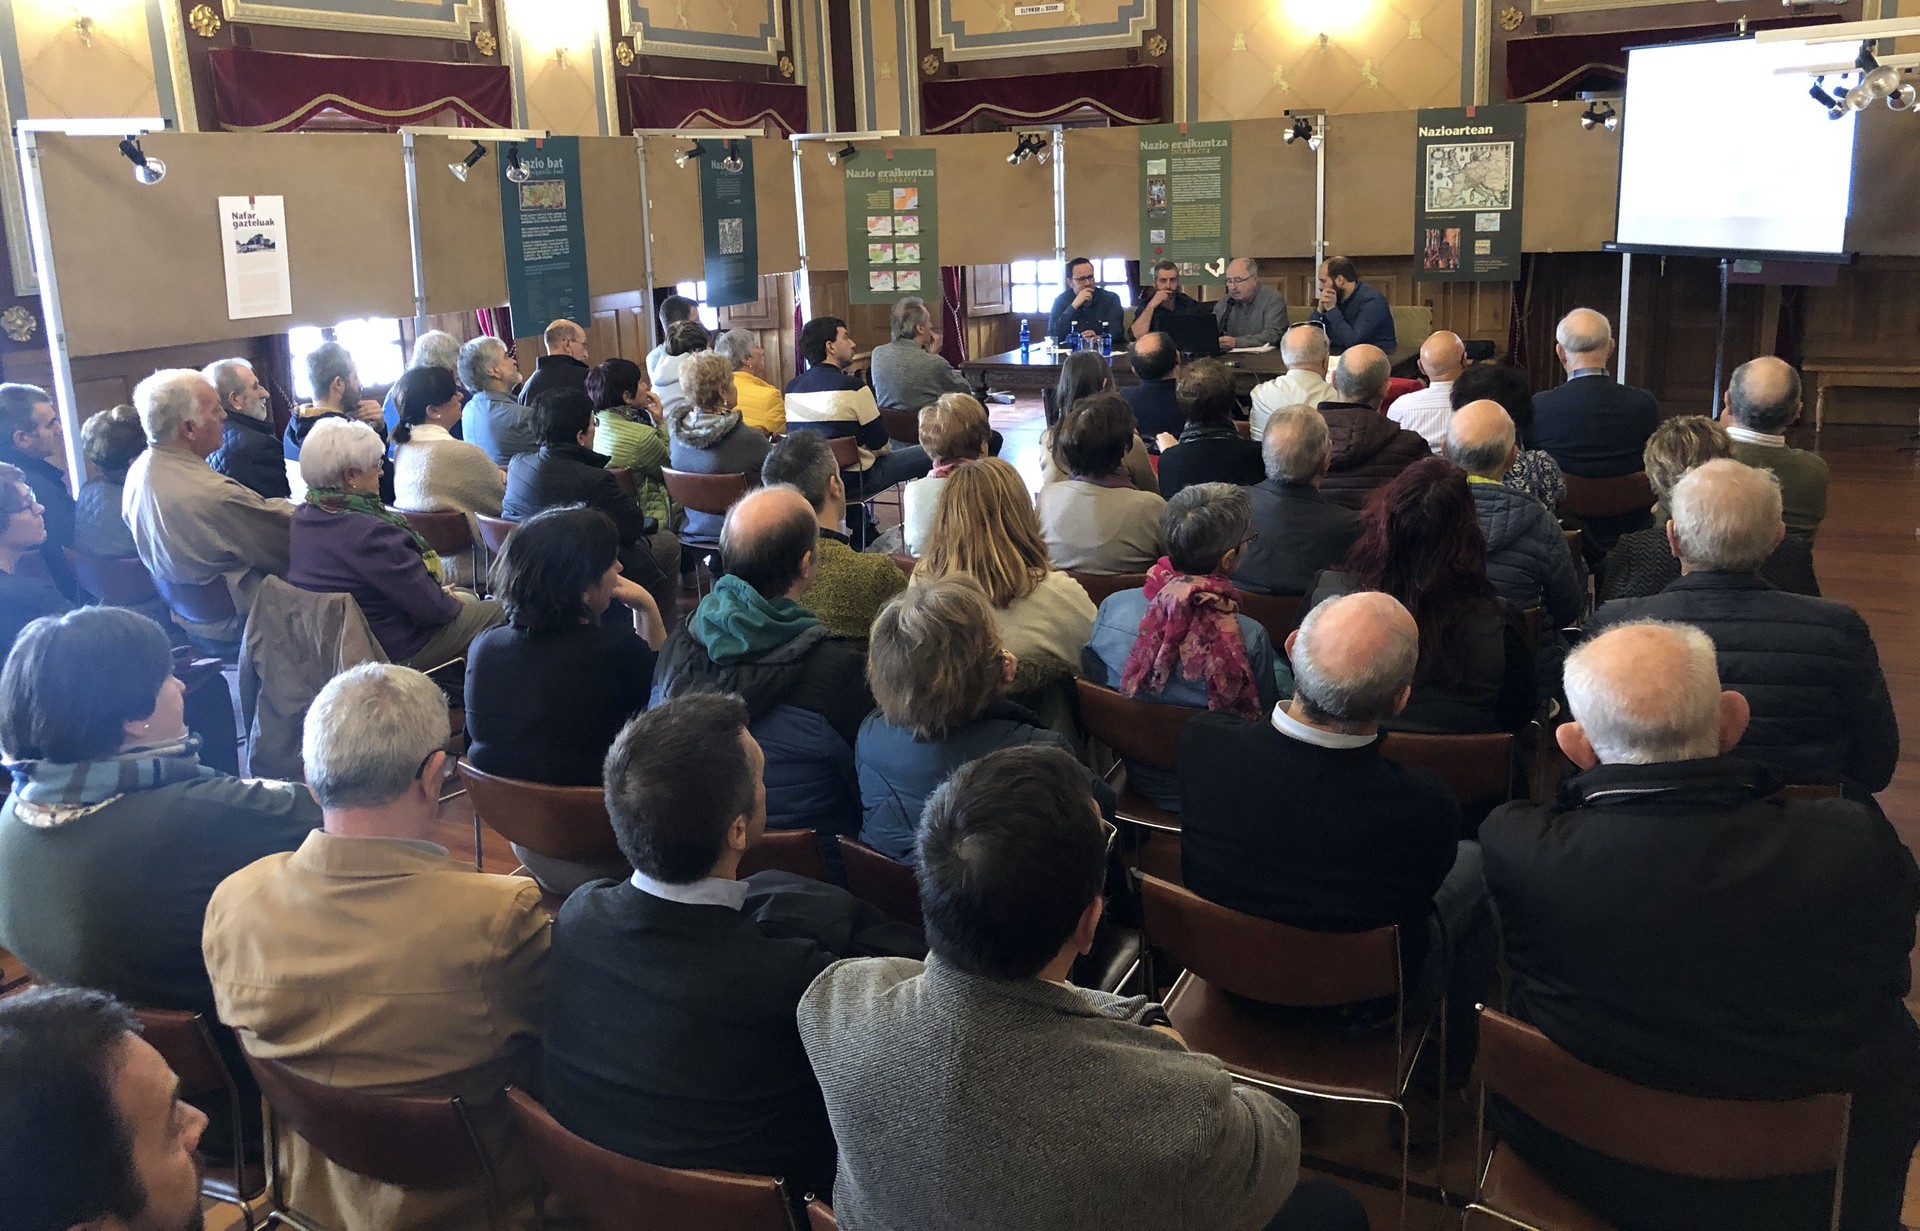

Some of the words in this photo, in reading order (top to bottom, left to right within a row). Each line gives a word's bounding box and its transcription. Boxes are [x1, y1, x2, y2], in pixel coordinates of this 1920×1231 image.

[1419, 125, 1494, 137] Nazioartean
[1140, 140, 1170, 150] Nazio
[1171, 138, 1228, 149] eraikuntza
[546, 156, 564, 169] bat
[846, 168, 876, 179] Nazio
[877, 167, 935, 178] eraikuntza
[231, 211, 257, 221] Nafar
[232, 217, 276, 231] gazteluak
